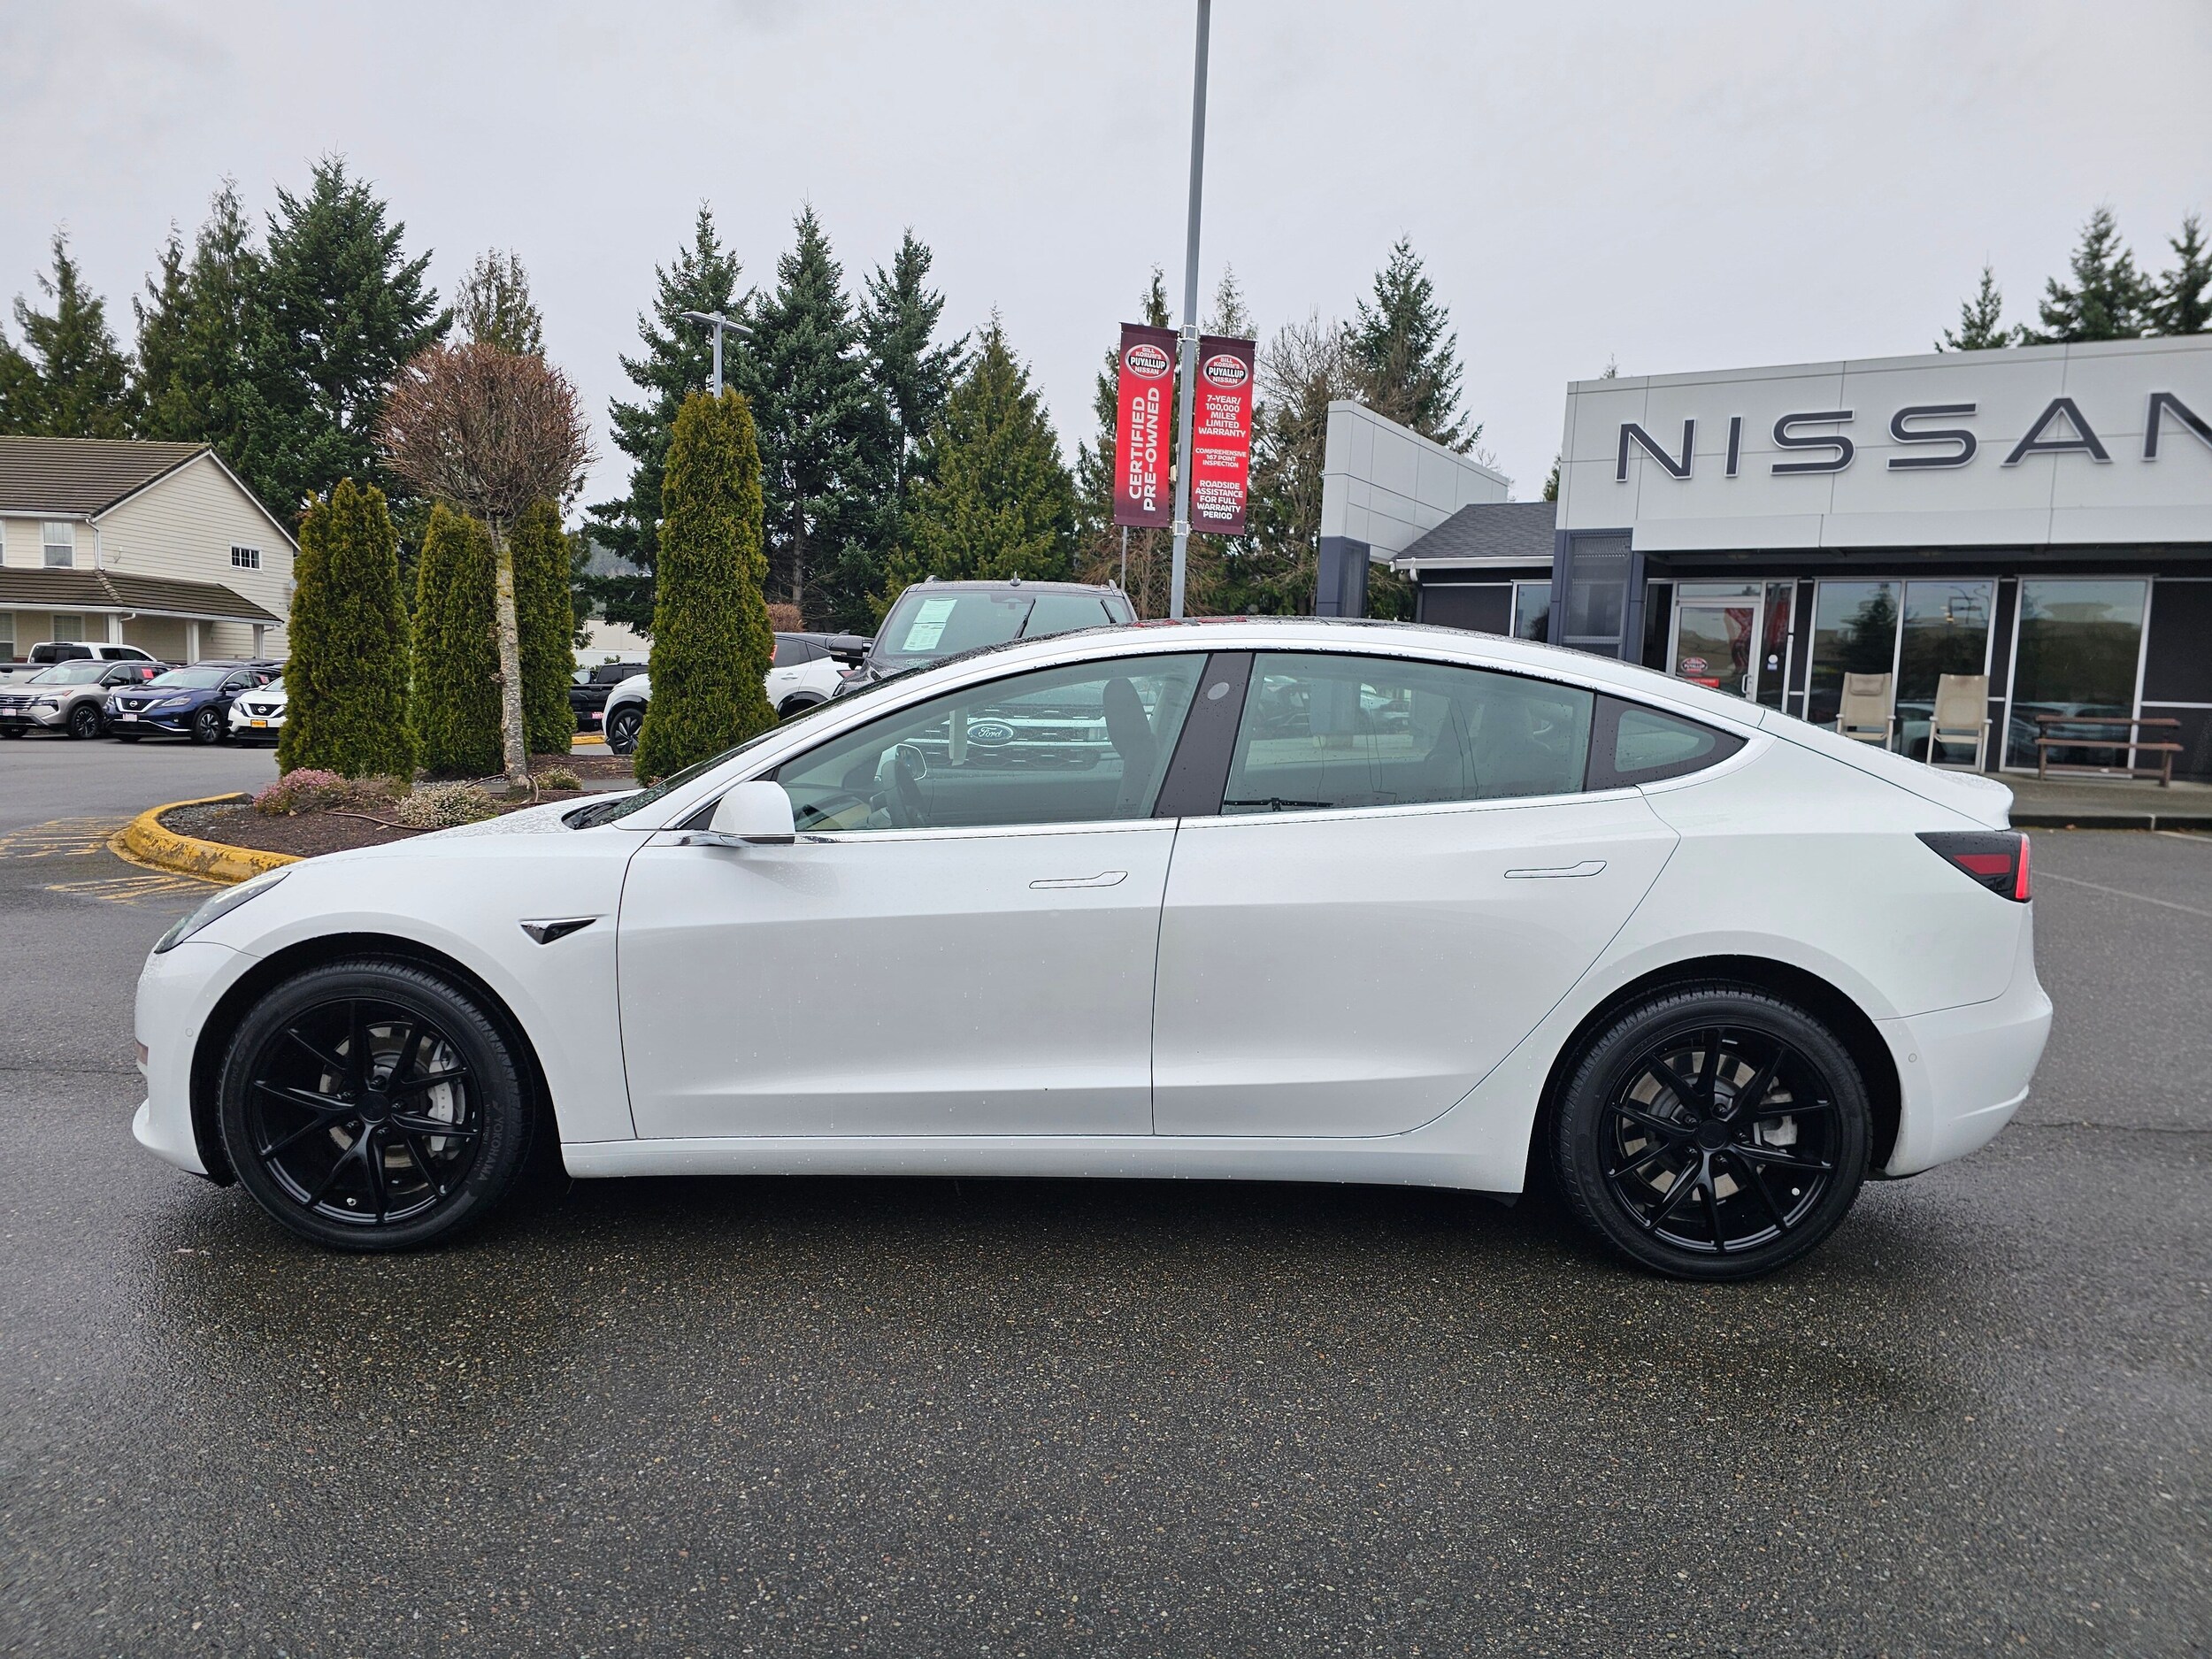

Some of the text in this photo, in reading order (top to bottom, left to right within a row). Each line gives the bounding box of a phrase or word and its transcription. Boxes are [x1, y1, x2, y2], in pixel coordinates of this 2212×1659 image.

[1130, 357, 1166, 370] PUYALLUP
[1134, 366, 1159, 375] NISSAN
[1208, 367, 1245, 379] PUYALLUP
[1206, 395, 1241, 405] 7-YEAR/
[1205, 403, 1240, 413] 100,000
[1210, 411, 1236, 420] MILES
[1206, 419, 1240, 429] LIMITED
[1198, 427, 1246, 438] WARRANTY
[1615, 391, 2212, 482] NISSAN
[1129, 396, 1146, 499] CERTIFIED
[1143, 388, 1160, 511] PRE-OWNED
[1195, 448, 1247, 457] COMPREHENSIVE
[1199, 480, 1240, 490] ROADSIDE
[1195, 488, 1243, 498] ASSISTANCE
[1196, 503, 1240, 513] WARRANTY
[1202, 511, 1233, 520] PERIOD
[979, 726, 1002, 738] Ford
[477, 1117, 503, 1180] YOKOHAMA
